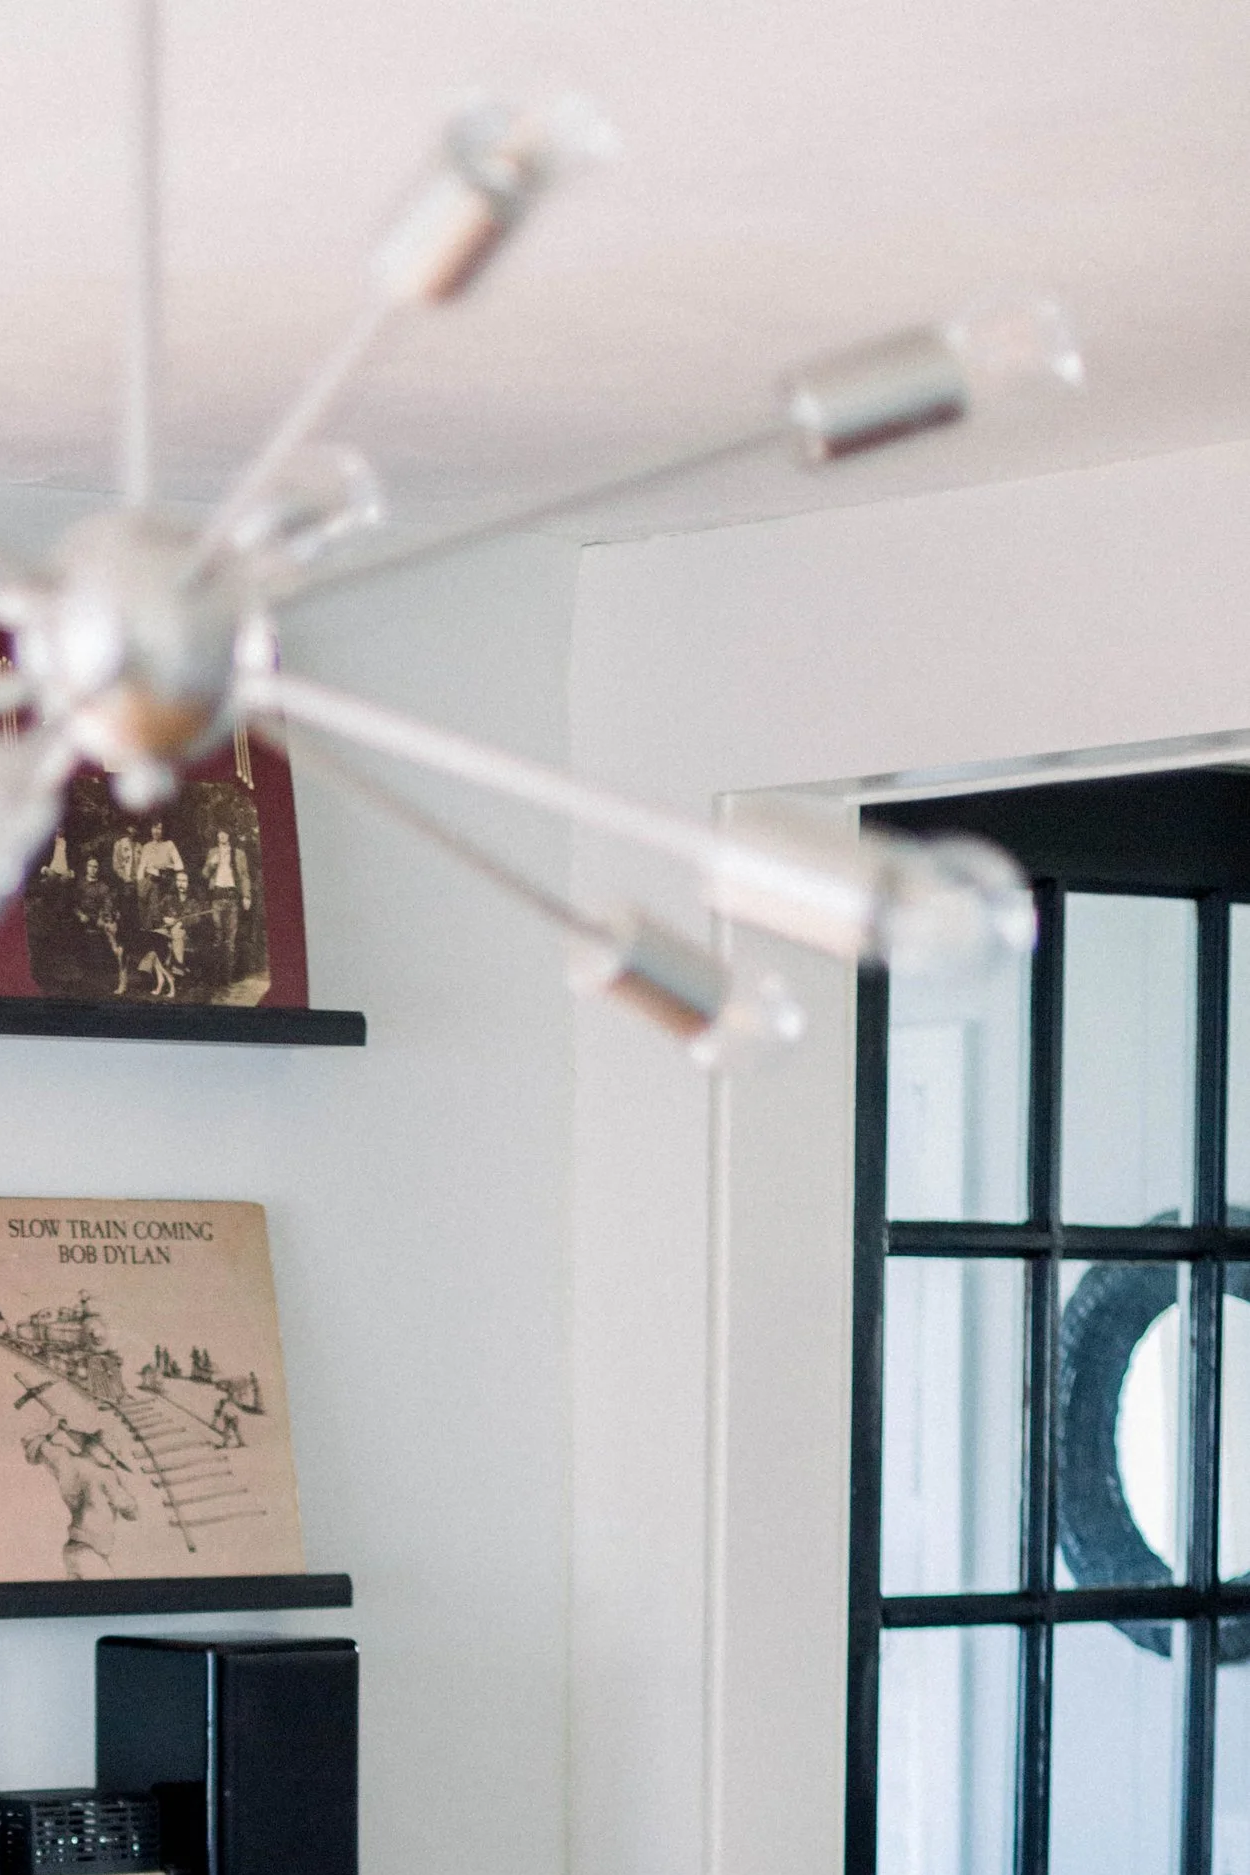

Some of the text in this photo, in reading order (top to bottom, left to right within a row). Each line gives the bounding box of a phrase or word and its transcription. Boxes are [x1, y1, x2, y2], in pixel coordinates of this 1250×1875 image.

[8, 1219, 214, 1241] SLOW TRAIN COMING
[58, 1244, 171, 1265] BOB DYLAN
